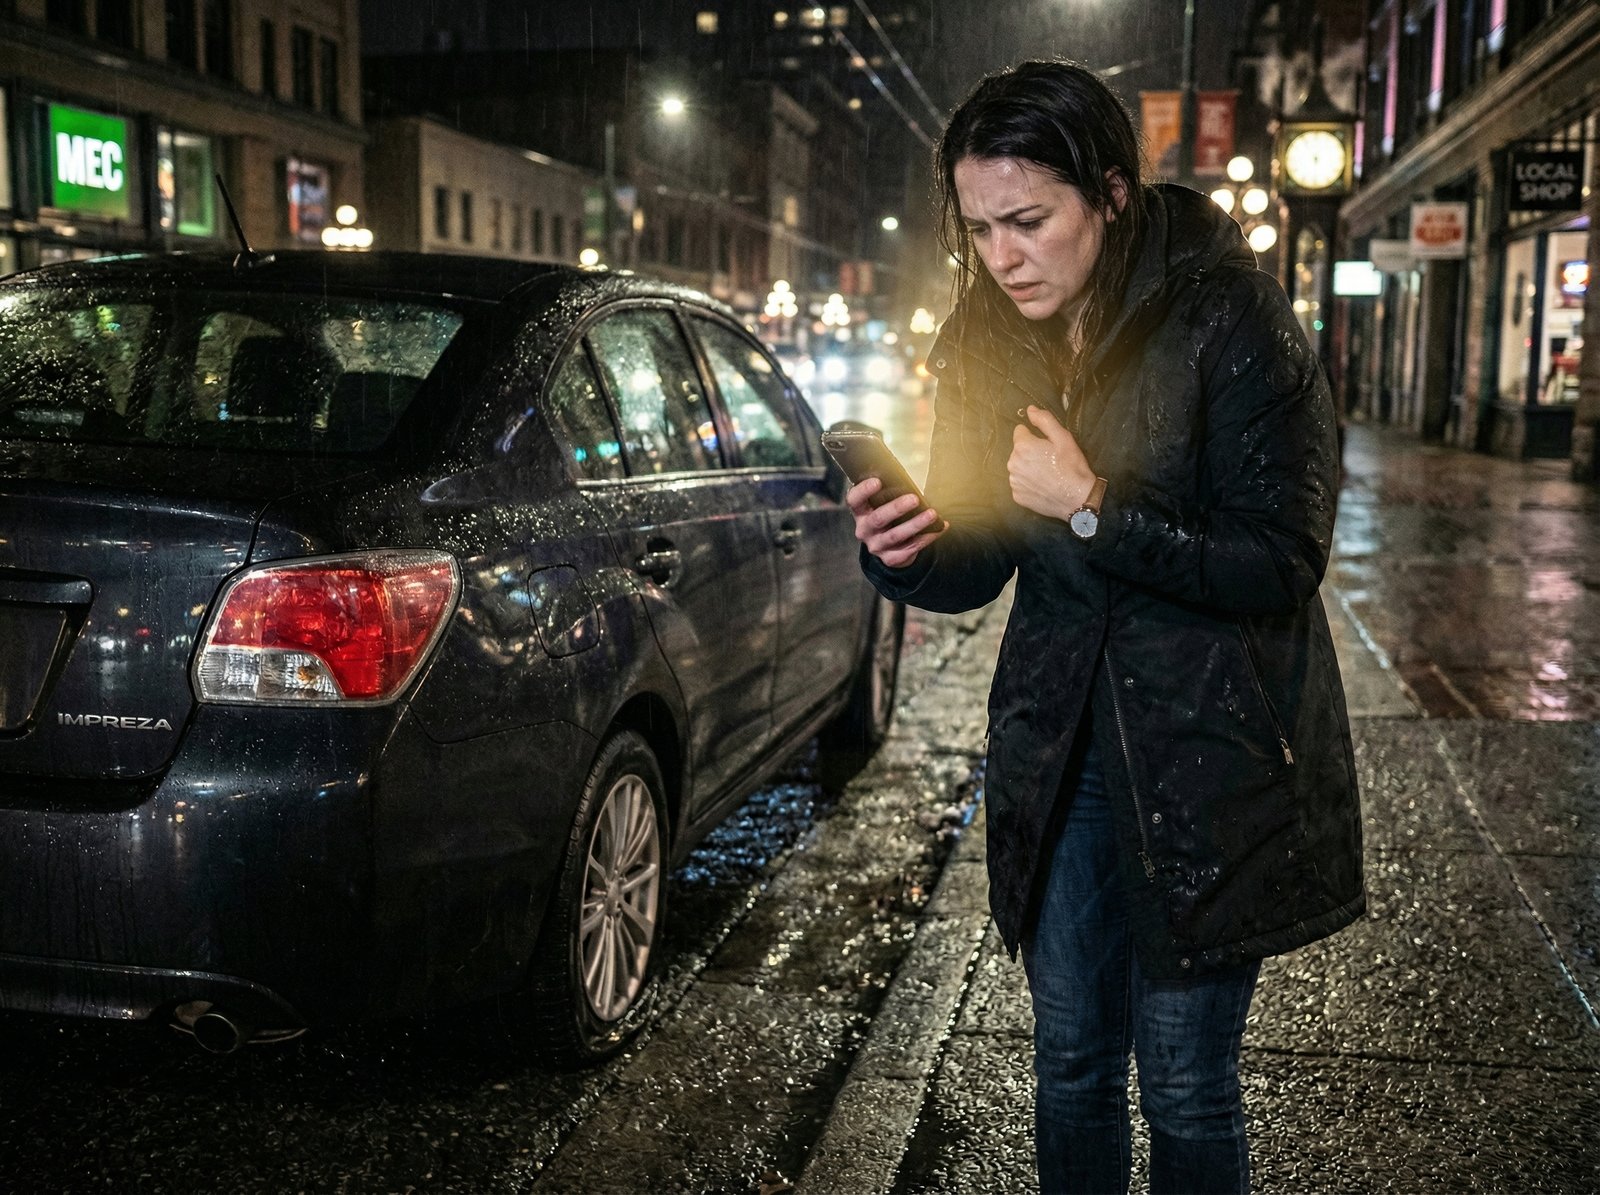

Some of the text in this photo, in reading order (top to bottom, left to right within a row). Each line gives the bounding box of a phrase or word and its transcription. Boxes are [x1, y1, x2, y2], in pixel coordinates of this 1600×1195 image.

[56, 132, 123, 192] MEC
[1516, 162, 1577, 180] LOCAL
[1520, 182, 1573, 201] SHOP
[57, 712, 173, 731] IMPREZA
